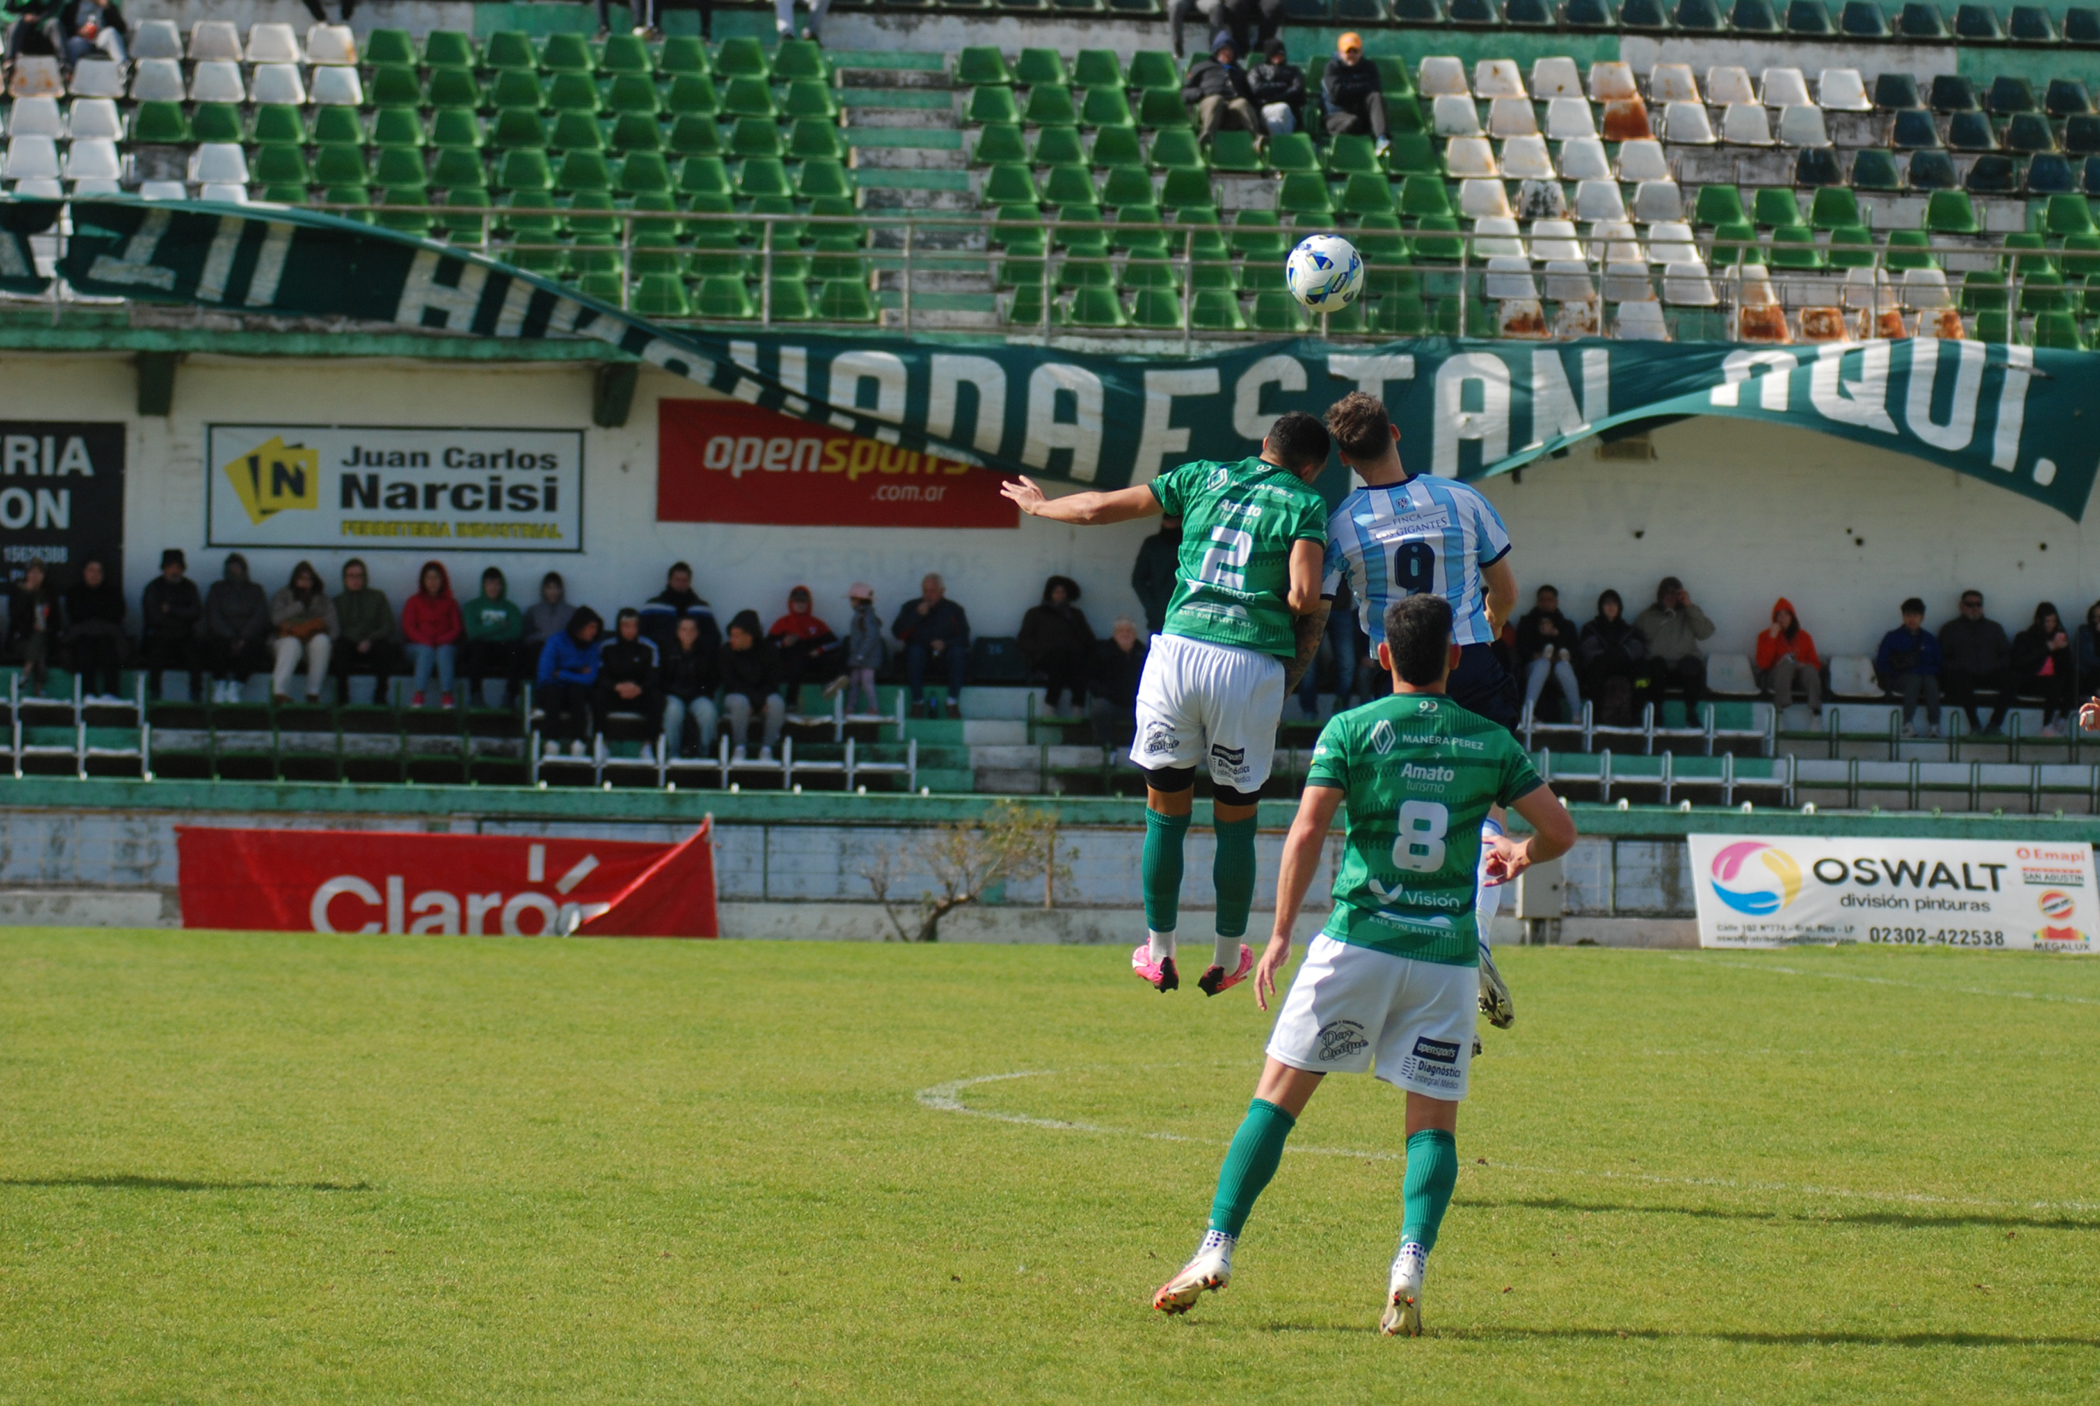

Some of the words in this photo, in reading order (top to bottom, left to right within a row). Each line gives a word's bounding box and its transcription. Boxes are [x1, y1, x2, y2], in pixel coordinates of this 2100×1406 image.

[0, 435, 96, 477] RIA
[340, 446, 430, 469] Juan
[443, 446, 558, 471] Carlos
[703, 435, 970, 481] openspo
[340, 473, 559, 512] Narcisi
[1217, 498, 1263, 517] Amato
[341, 520, 451, 538] FERRETERIA
[455, 521, 563, 539] INDUSTRIAL
[1392, 513, 1423, 526] FINCA
[1395, 516, 1449, 538] GIGANTES
[1199, 526, 1253, 590] 2
[1394, 541, 1436, 596] 9
[1402, 734, 1450, 745] MANERA
[1451, 737, 1485, 750] PEREZ
[1401, 762, 1455, 782] Amato
[1406, 779, 1446, 794] turismo
[1392, 800, 1449, 873] 8
[2034, 848, 2086, 862] Emapi
[1812, 857, 2008, 892] OSWALT
[2022, 873, 2042, 881] SAN
[309, 874, 560, 936] Claro
[1405, 891, 1460, 909] Visión
[1840, 893, 1908, 911] división
[1914, 895, 1991, 913] pinturas
[1869, 926, 2005, 947] 02302-422538
[2033, 941, 2091, 952] MEGALUX
[1417, 1043, 1457, 1058] opensports
[1414, 1073, 1441, 1087] Integral
